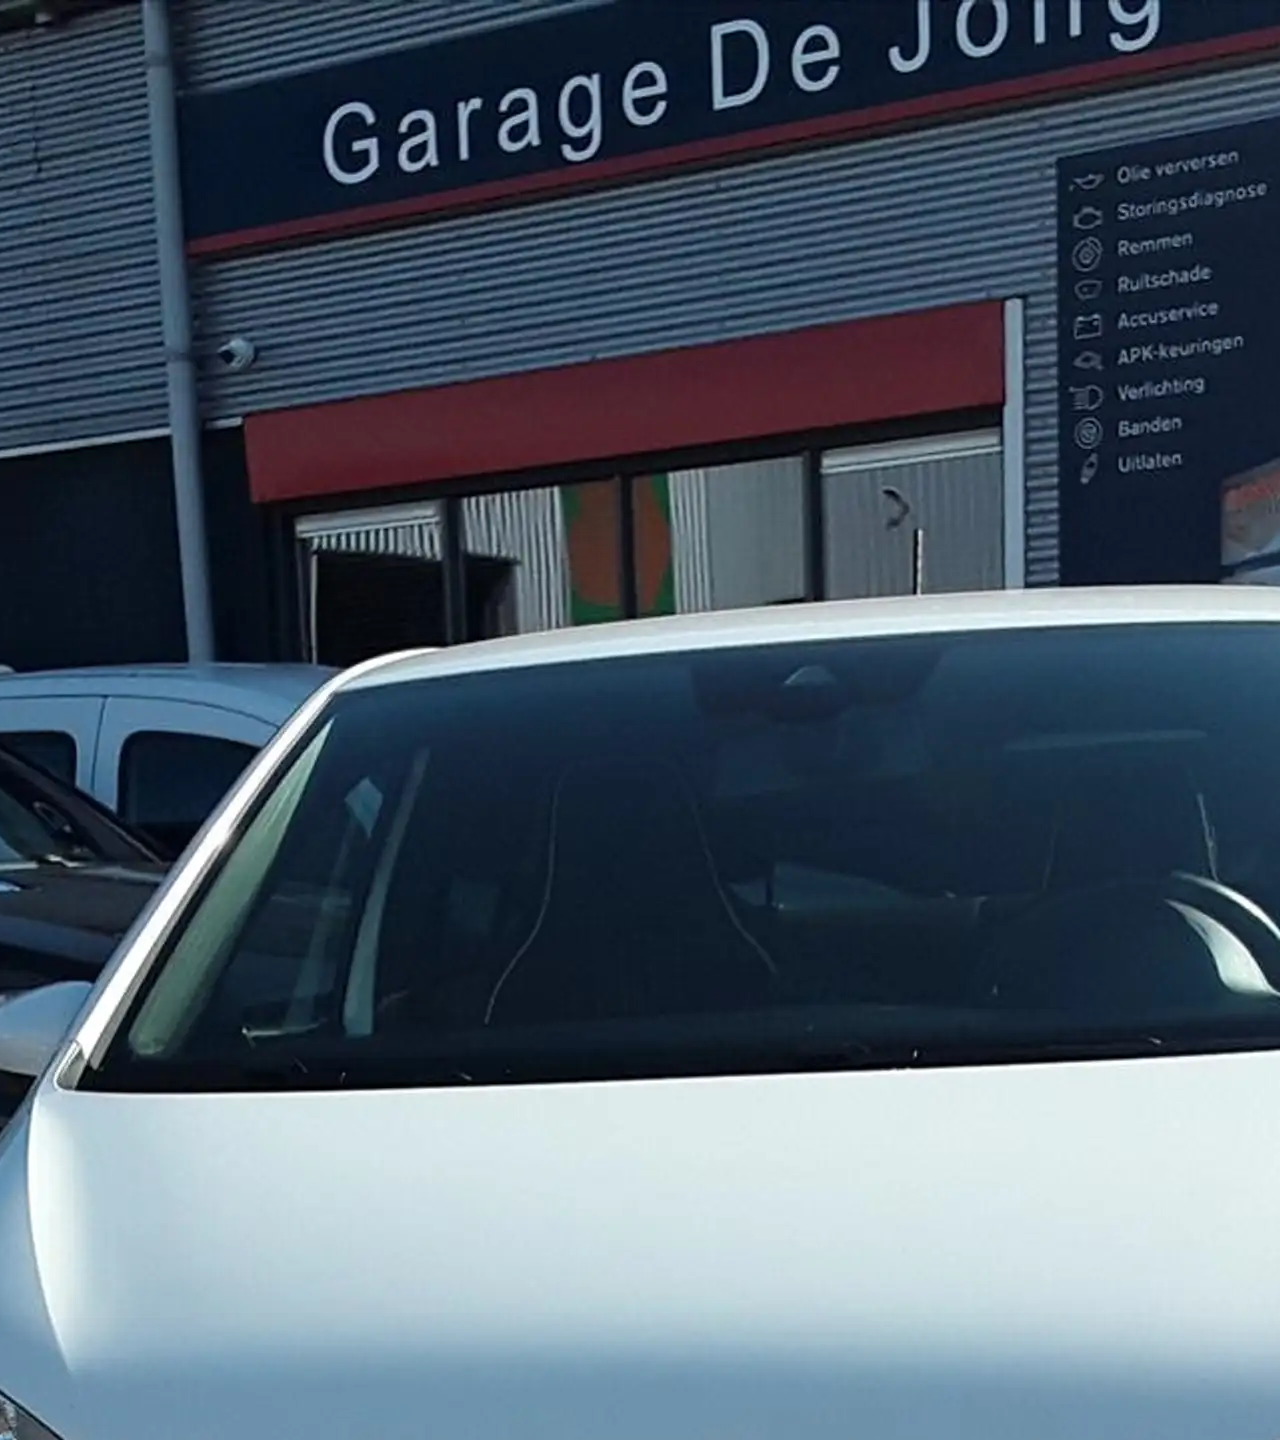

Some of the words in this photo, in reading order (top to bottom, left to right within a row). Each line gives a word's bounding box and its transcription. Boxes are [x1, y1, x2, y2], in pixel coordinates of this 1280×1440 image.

[322, 60, 668, 186] Garage
[709, 18, 841, 111] De
[1117, 165, 1151, 183] Olie
[1154, 150, 1240, 177] verversen
[1117, 182, 1268, 221] Storingsdiagnose
[1117, 232, 1193, 257] Remmen
[1117, 265, 1213, 294] Ruitschade
[1117, 302, 1219, 329] Accuservice
[1117, 335, 1245, 366] APK-keuringen
[1117, 377, 1205, 401] Verlichting
[1117, 416, 1183, 438] Banden
[1117, 453, 1183, 473] Uitlaten
